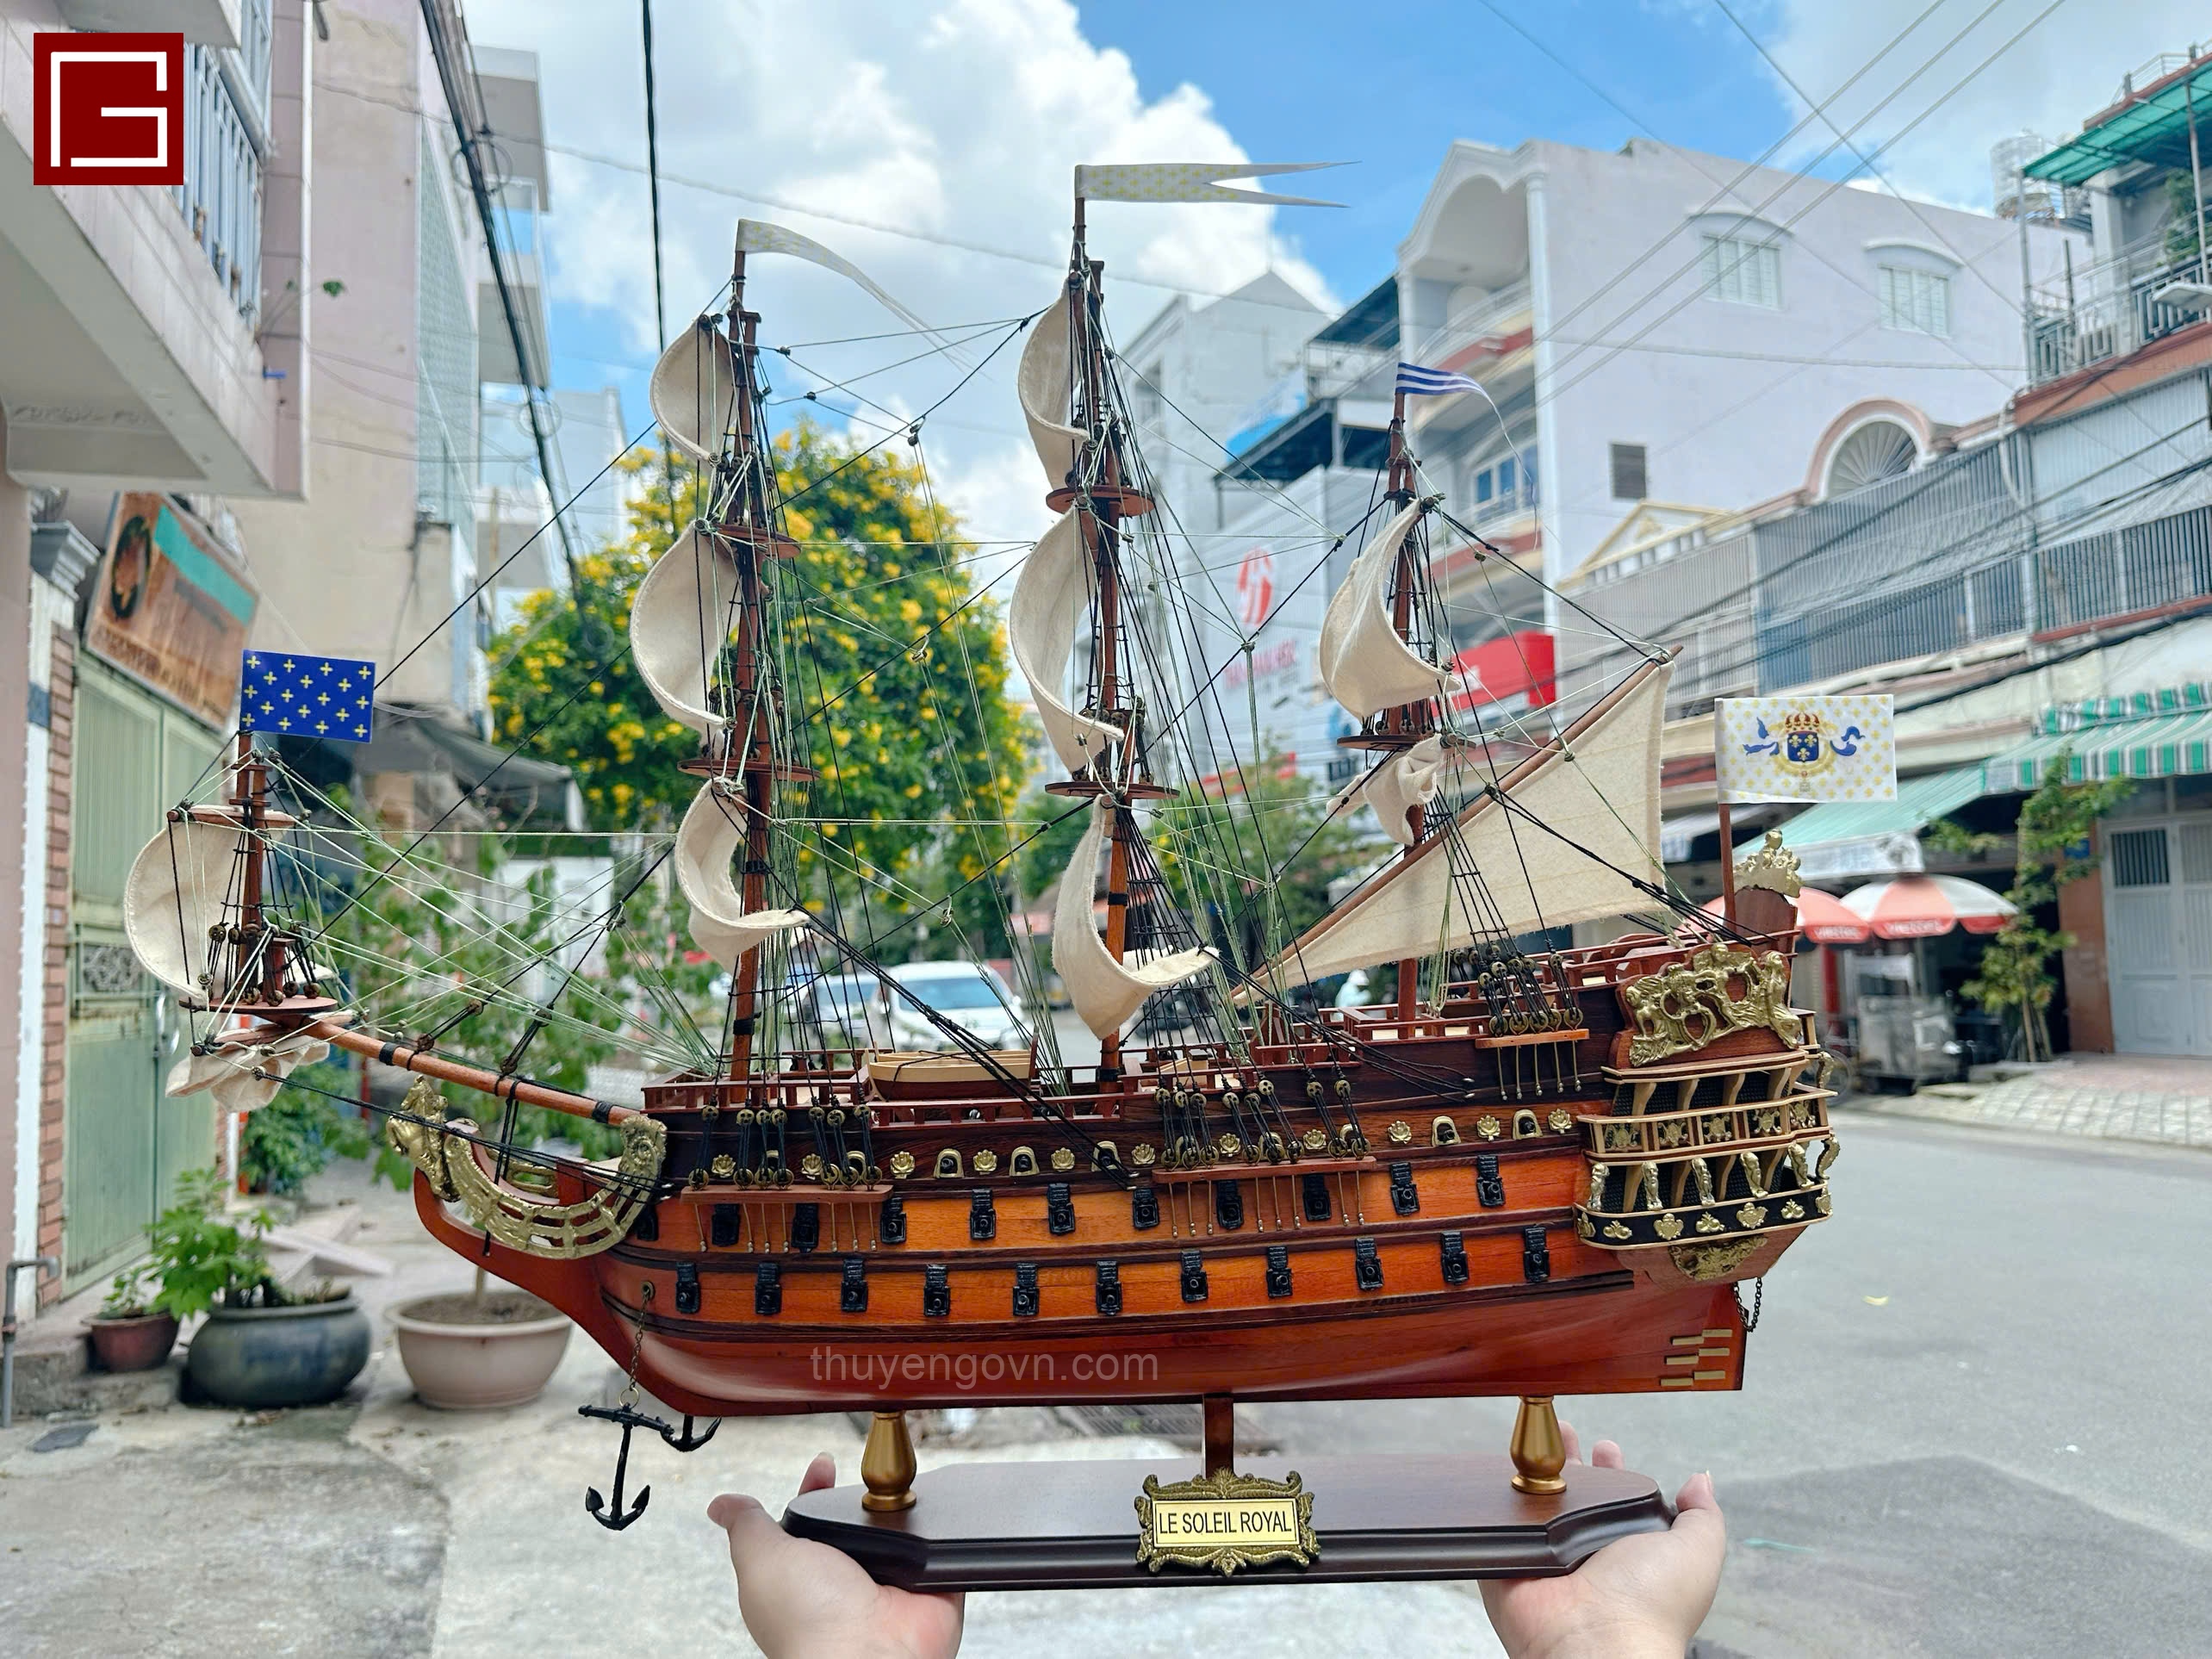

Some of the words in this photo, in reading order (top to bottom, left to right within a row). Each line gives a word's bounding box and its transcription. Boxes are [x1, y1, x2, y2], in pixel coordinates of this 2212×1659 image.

[1159, 1513, 1178, 1534] LE
[1182, 1512, 1237, 1533] SOLEIL
[1240, 1511, 1292, 1532] ROYAL
